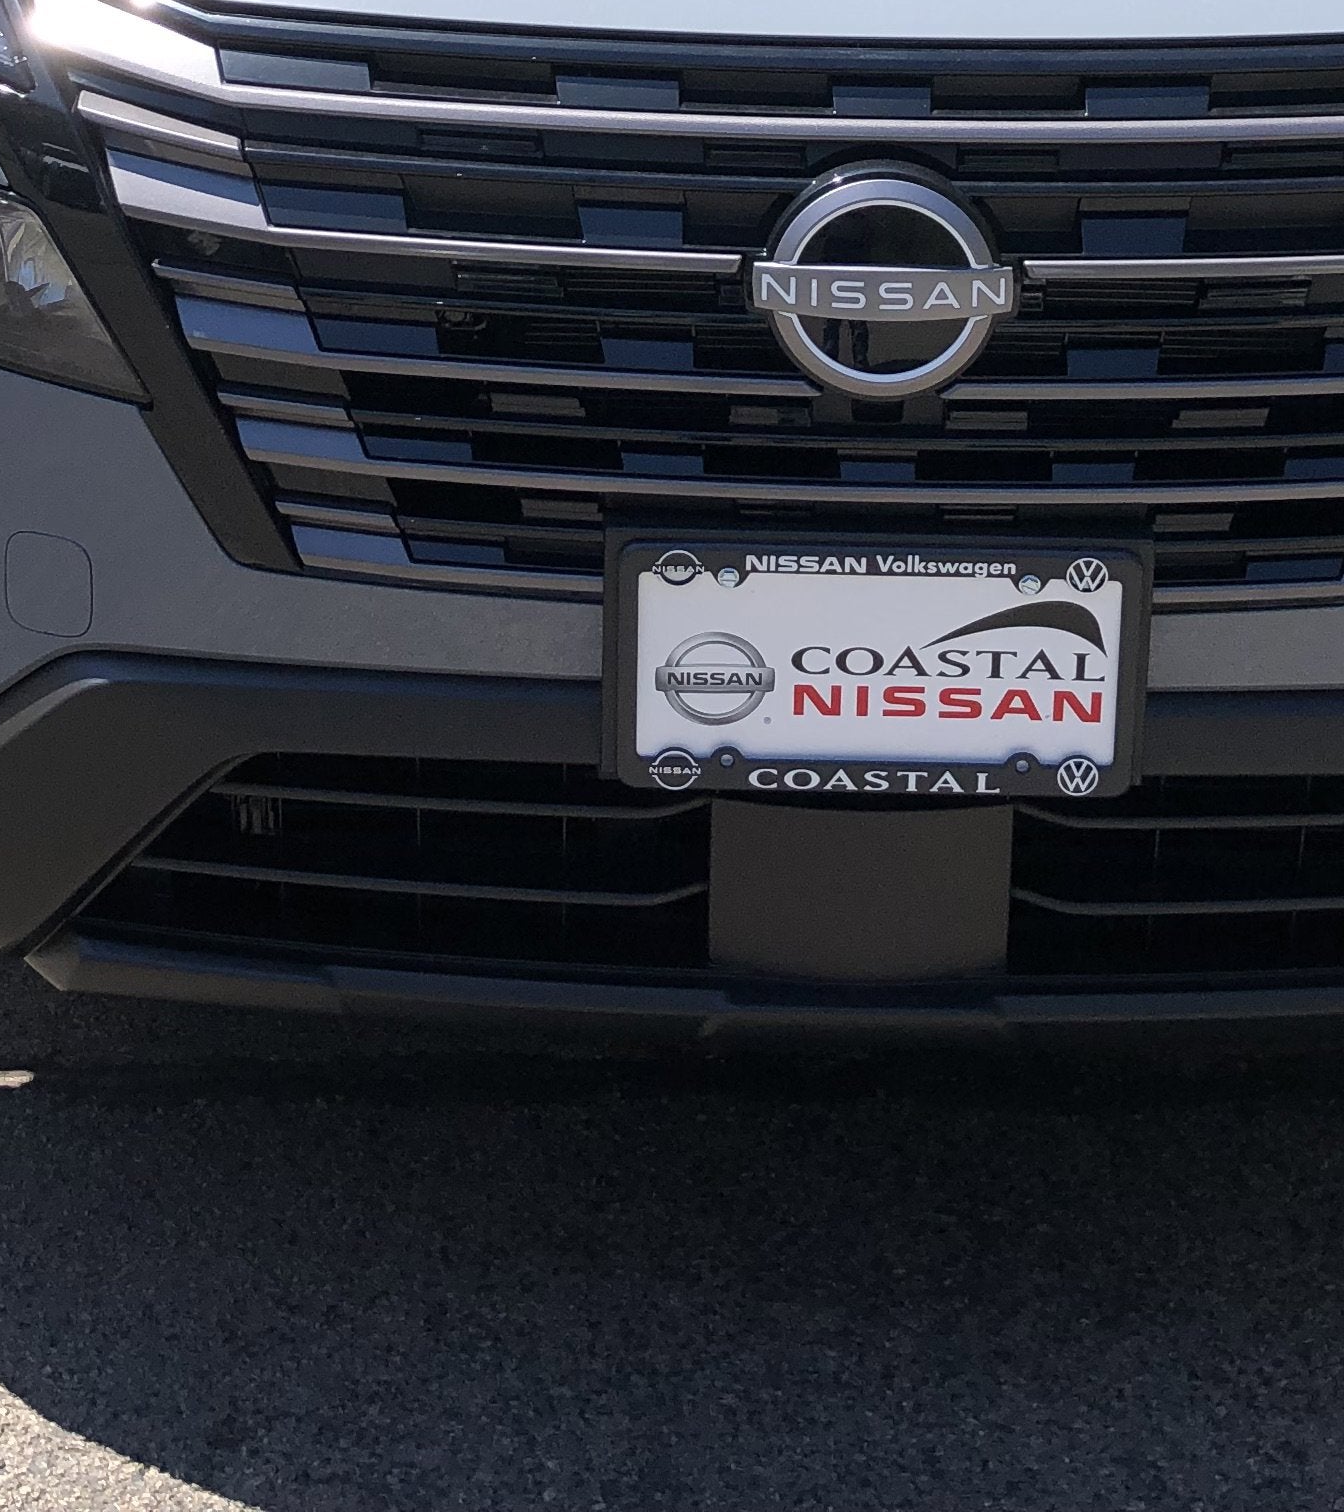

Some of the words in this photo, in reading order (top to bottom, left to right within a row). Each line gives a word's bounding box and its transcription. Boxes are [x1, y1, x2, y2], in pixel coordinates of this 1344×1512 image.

[761, 274, 1006, 310] NISSAN
[652, 565, 705, 574] NISSAN
[745, 554, 867, 574] NISSAN
[875, 554, 1017, 578] Volkswagen
[790, 645, 1106, 682] COASTAL
[666, 670, 764, 687] NISSAN
[791, 683, 1104, 723] NISSAN
[648, 766, 702, 775] NISSAN
[748, 768, 1001, 794] COASTAL
